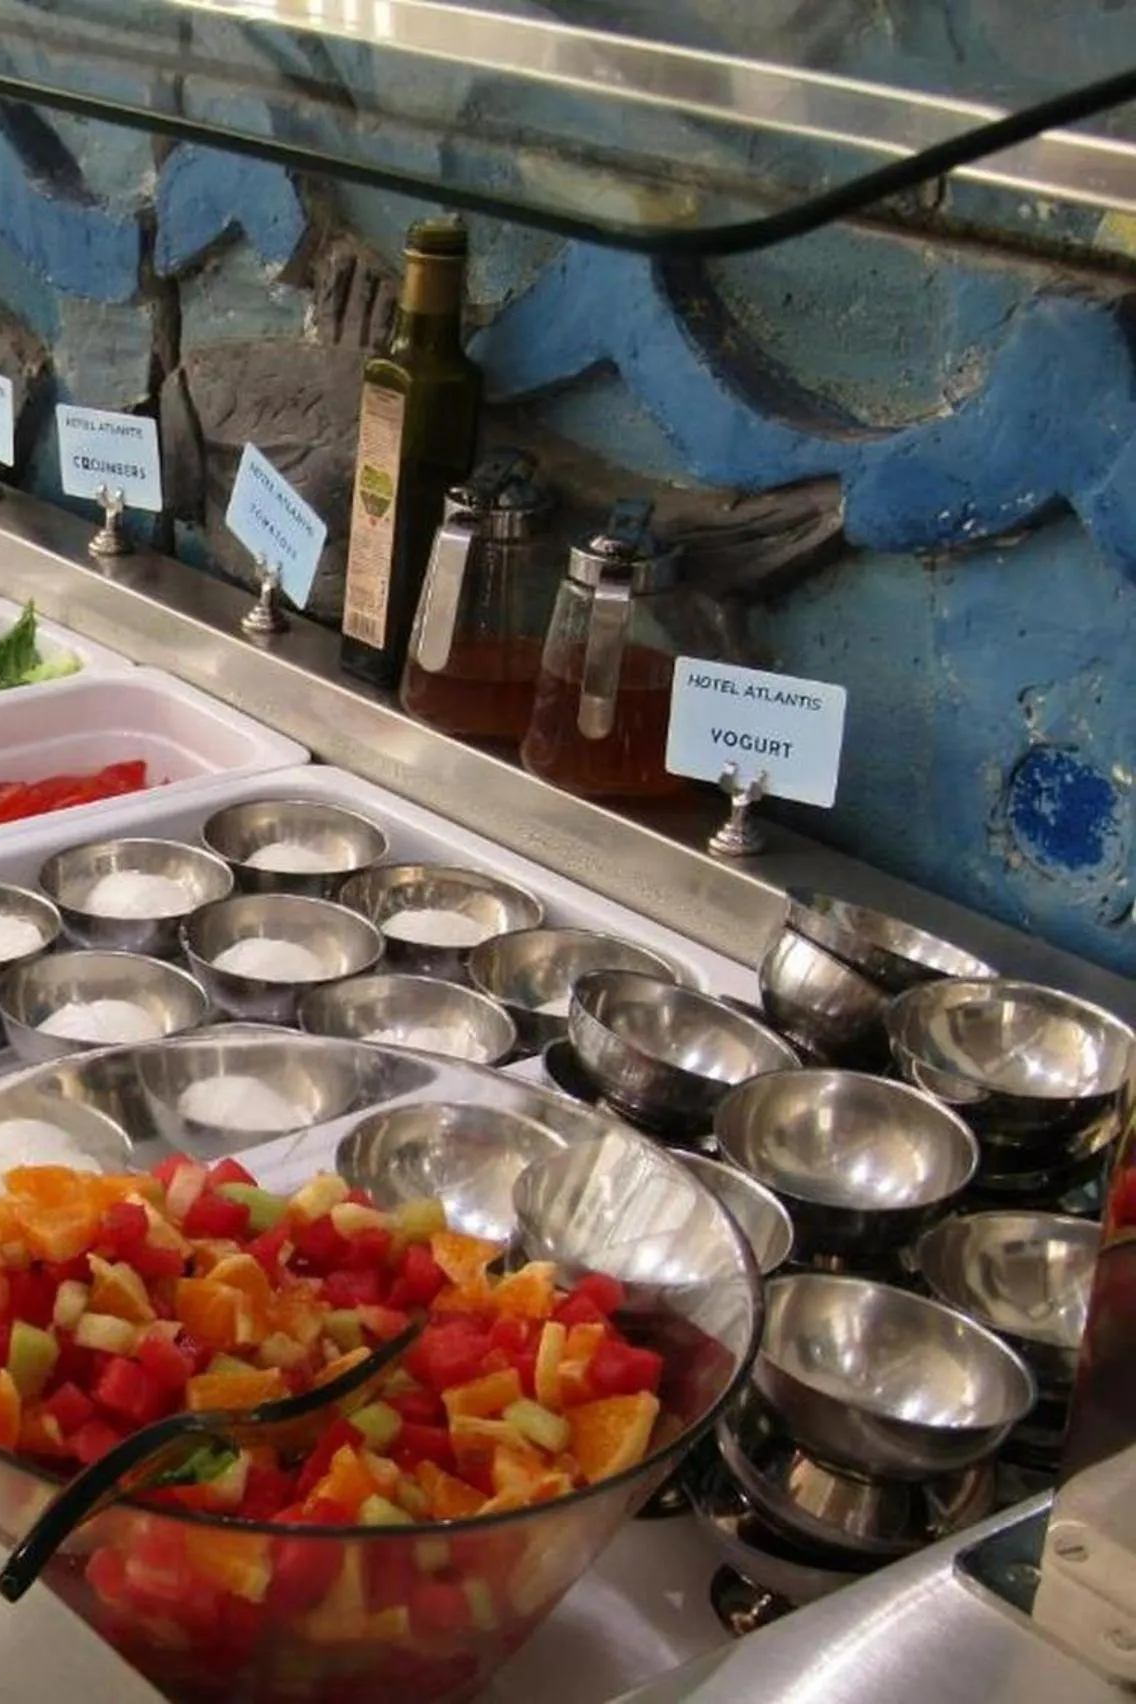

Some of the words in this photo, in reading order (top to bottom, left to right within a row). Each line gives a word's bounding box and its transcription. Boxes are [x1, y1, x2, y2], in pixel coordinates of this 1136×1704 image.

[687, 672, 740, 696] HOTEL
[743, 684, 824, 712] ATLANTIS
[710, 727, 793, 759] YOGURT
